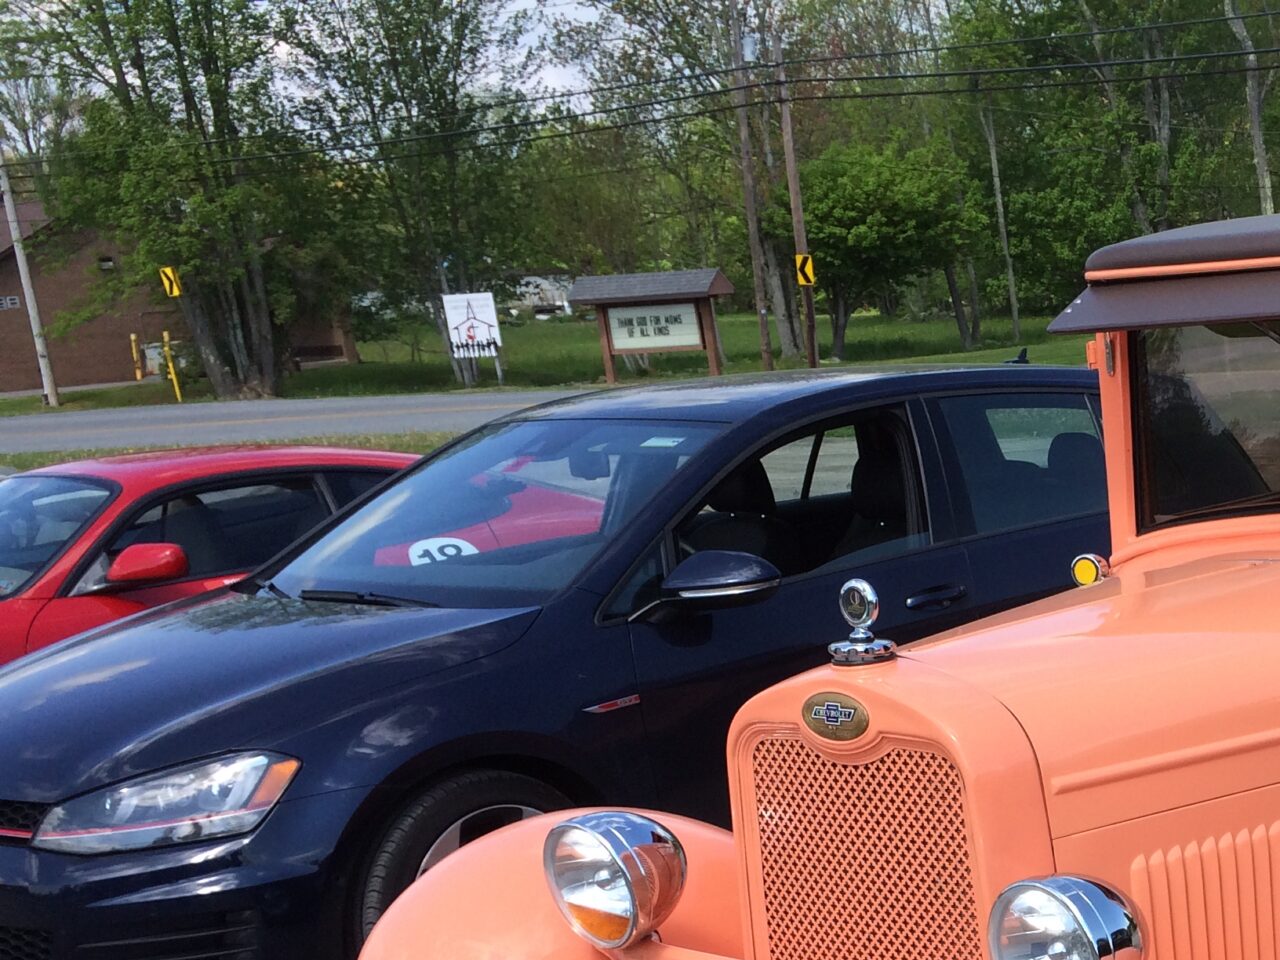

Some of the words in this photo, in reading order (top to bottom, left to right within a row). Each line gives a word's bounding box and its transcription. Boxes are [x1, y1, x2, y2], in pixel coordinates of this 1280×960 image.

[617, 317, 634, 328] THANK
[636, 316, 648, 327] GOD
[649, 315, 662, 326] FOR
[815, 709, 850, 719] CHEVROLET
